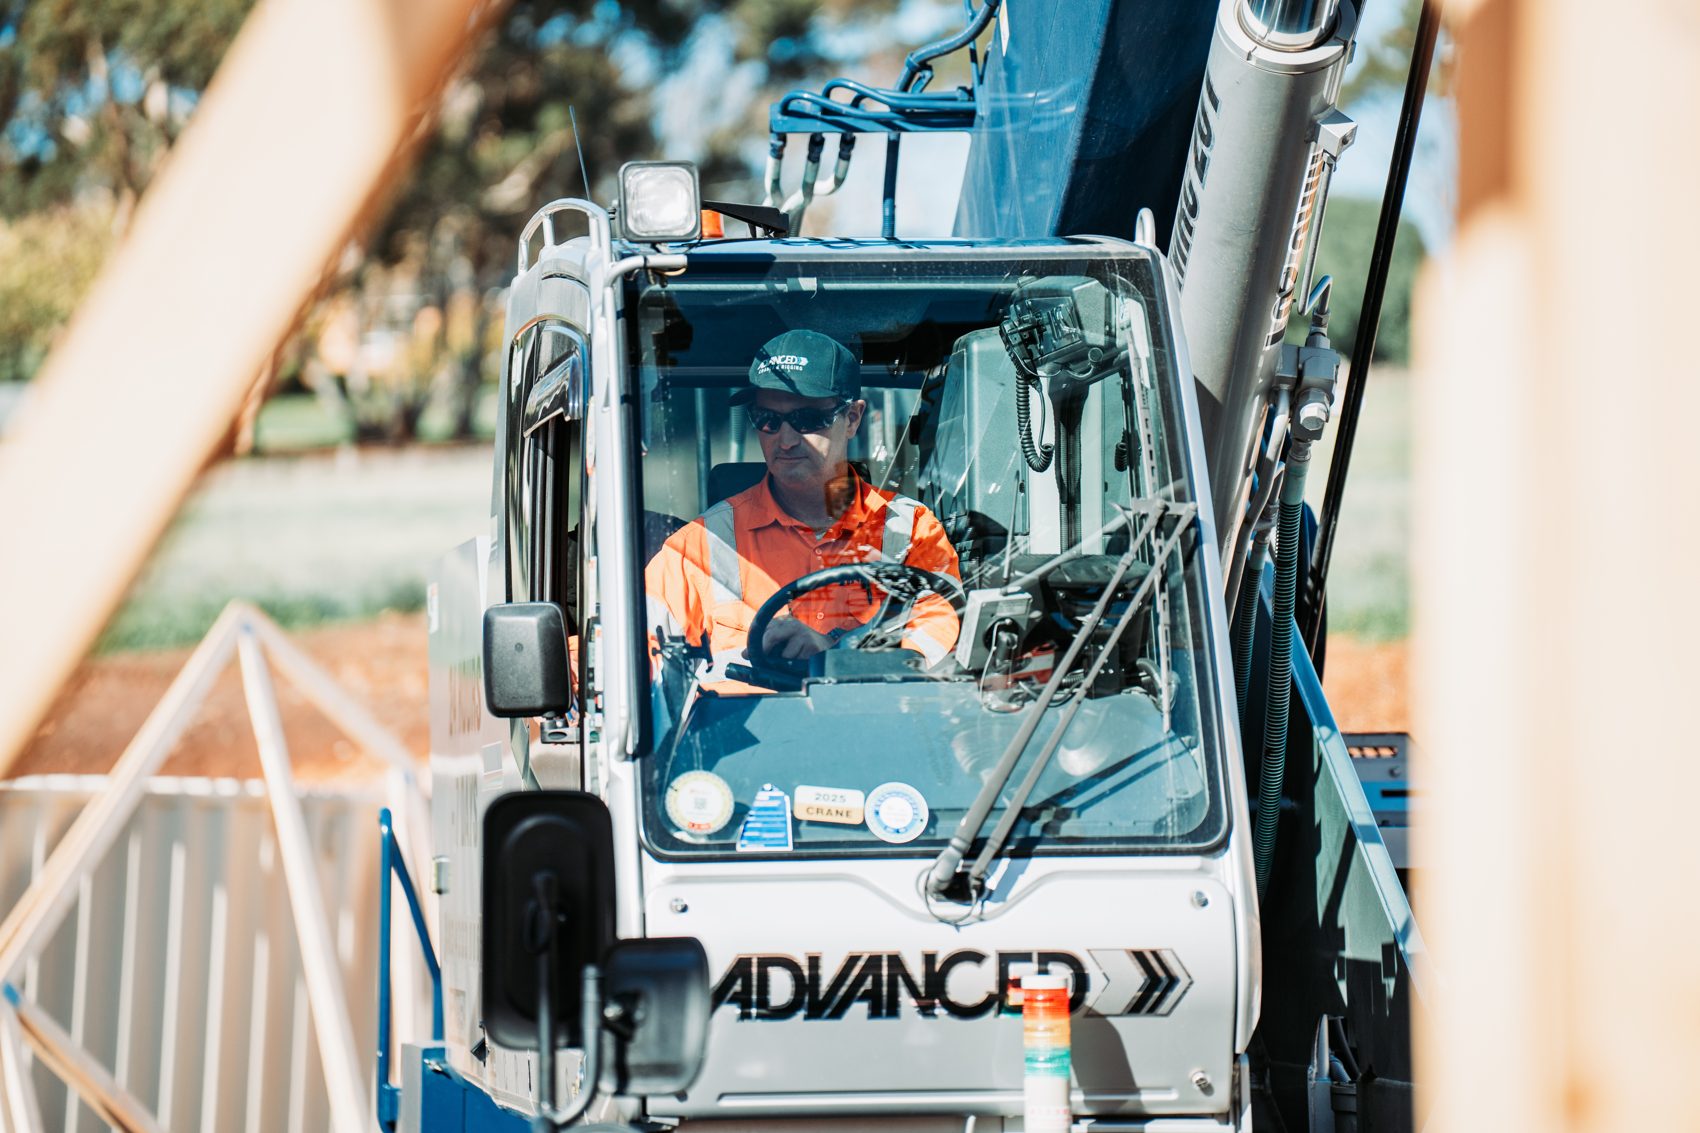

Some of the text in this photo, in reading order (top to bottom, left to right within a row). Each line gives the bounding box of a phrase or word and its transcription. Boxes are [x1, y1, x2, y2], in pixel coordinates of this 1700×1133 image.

[815, 792, 847, 803] 2025
[806, 806, 853, 818] CRANE
[709, 948, 1090, 1021] ADVANCED
